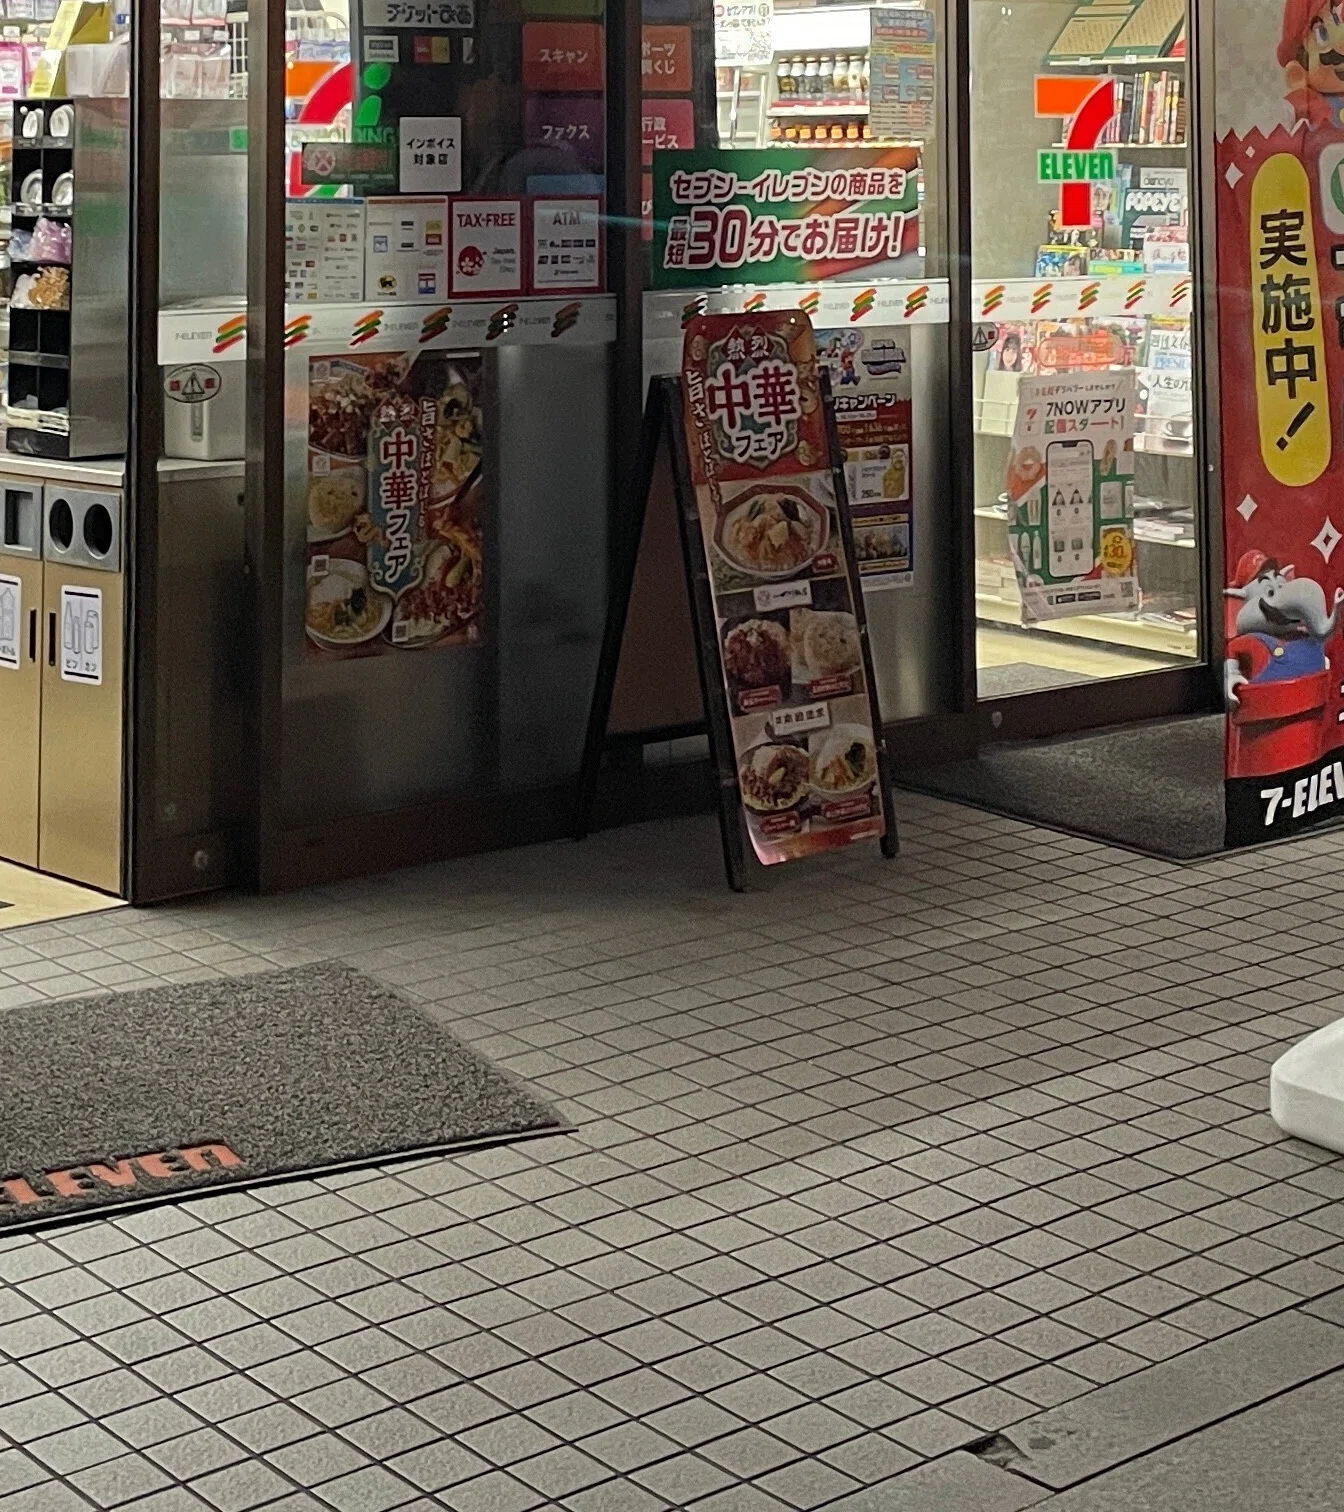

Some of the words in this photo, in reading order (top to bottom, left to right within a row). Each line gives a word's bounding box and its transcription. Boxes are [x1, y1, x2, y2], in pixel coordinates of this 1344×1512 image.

[539, 48, 589, 64] スキャン
[541, 124, 591, 141] ファクス
[406, 137, 456, 150] インボイス
[456, 212, 516, 228] TAX-FREE
[1259, 208, 1318, 452] 実施中!
[707, 364, 797, 431] 中華
[1045, 397, 1127, 418] 7NOWアプリ
[735, 431, 785, 460] フェア
[381, 430, 417, 583] 中華フェア
